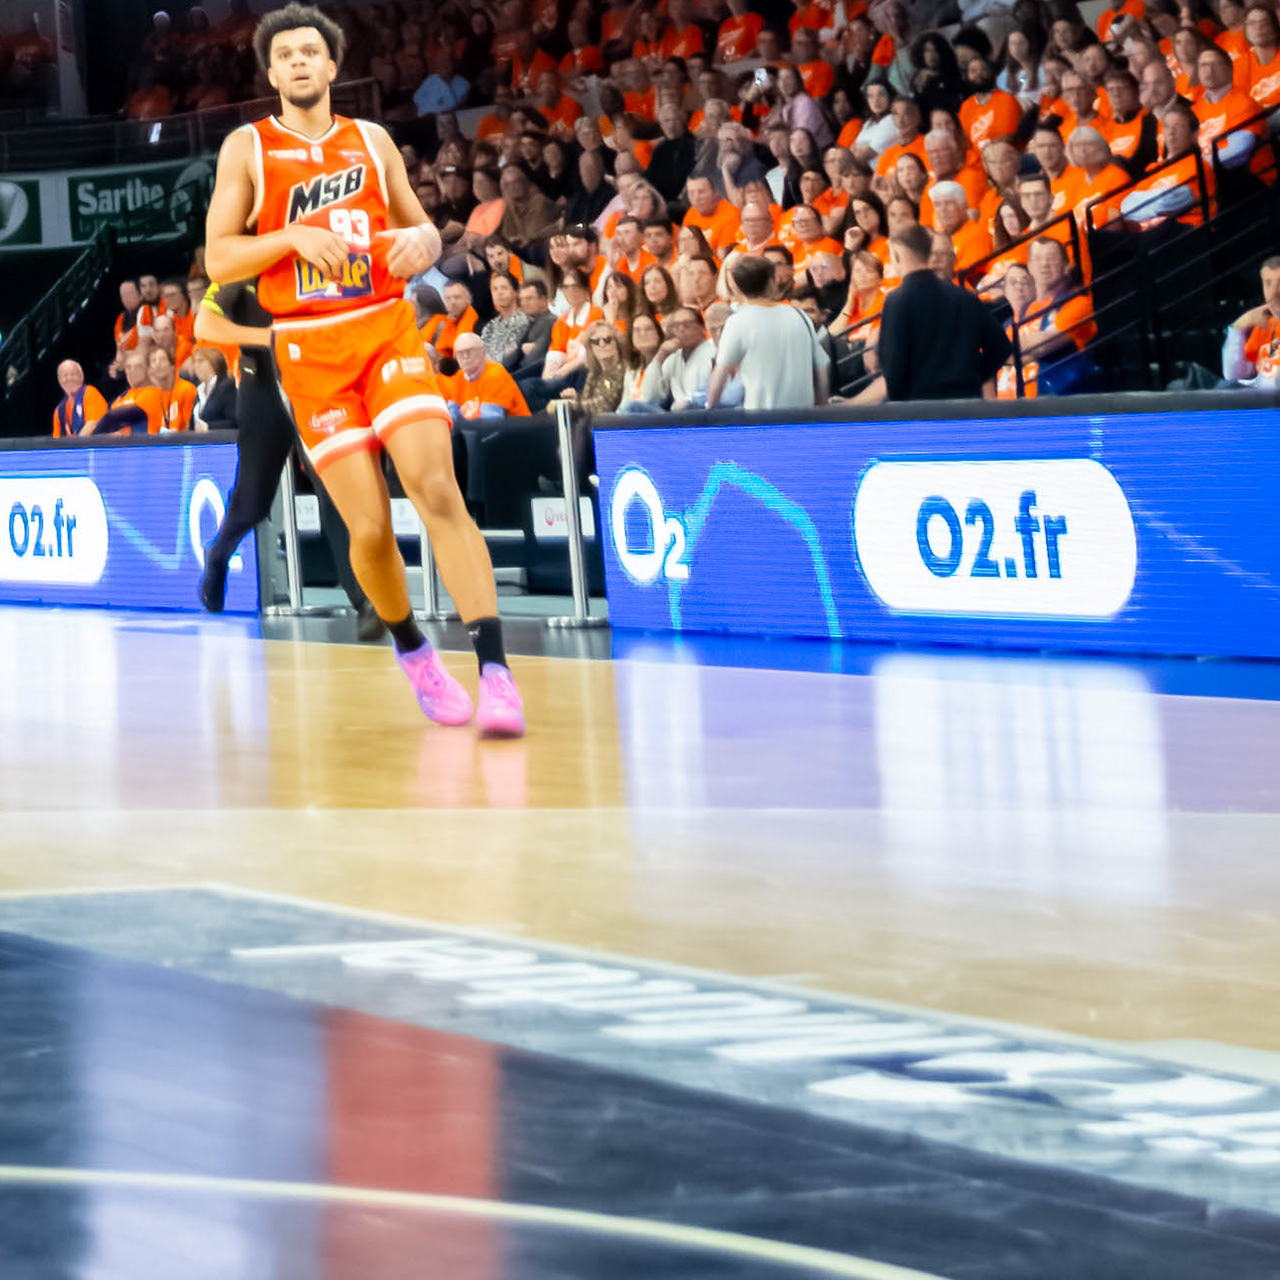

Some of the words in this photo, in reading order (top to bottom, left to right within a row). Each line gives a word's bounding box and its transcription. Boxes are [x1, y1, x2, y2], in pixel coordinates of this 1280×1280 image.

[77, 181, 166, 216] Sarthe
[286, 163, 367, 228] MSB
[329, 208, 371, 250] 93
[8, 497, 77, 559] O2.fr
[915, 489, 1068, 581] O2.fr
